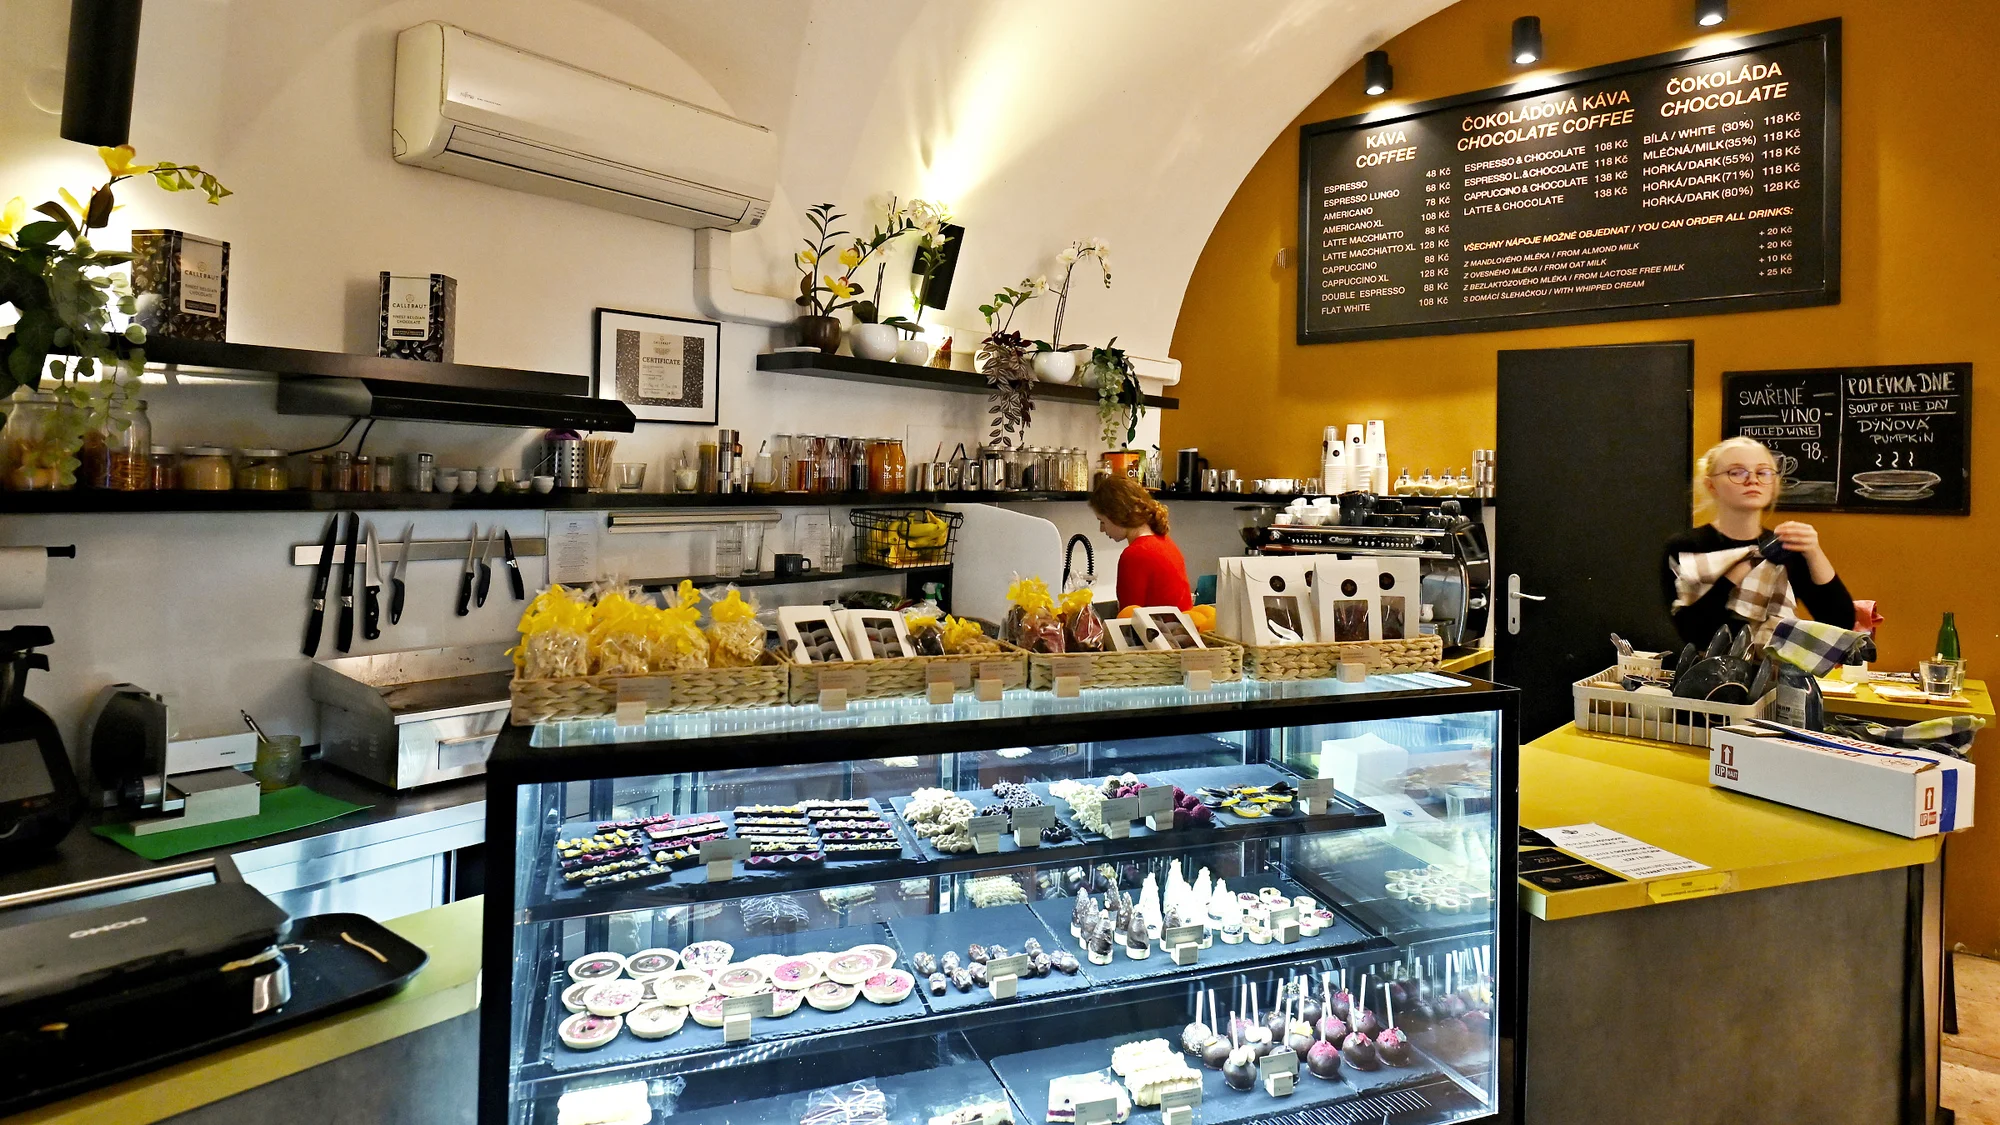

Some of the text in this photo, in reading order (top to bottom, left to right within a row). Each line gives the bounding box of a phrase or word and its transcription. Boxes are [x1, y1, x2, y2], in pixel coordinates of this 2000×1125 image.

[1666, 62, 1782, 95] ČOKOLÁDA
[1462, 90, 1630, 132] ČOKOLÁDOVÁ KÁVA
[1660, 82, 1789, 117] CHOCOLATE
[1457, 108, 1634, 151] CHOCOLATE COFFEE
[1643, 111, 1800, 144] BÍLÁ WHITE (30%) 118 Kč
[1763, 131, 1783, 142] 118
[1785, 128, 1800, 139] Kč
[1366, 131, 1406, 149] KÁVA
[1761, 148, 1782, 159] 118
[1785, 145, 1800, 156] Kč
[1355, 146, 1417, 168] COFFEE
[1464, 157, 1514, 172] ESPRESSO
[1524, 145, 1585, 163] CHOCOLATE
[1594, 141, 1612, 152] 108
[1614, 139, 1628, 149] Kč
[1324, 167, 1450, 194] ESPRESSO 48 Kč
[1464, 172, 1512, 186] ESPRESSO
[1594, 157, 1612, 167] 118
[1614, 154, 1628, 164] Kč
[1762, 165, 1782, 175] 118
[1785, 162, 1800, 172] Kč
[1323, 181, 1450, 207] ESPRESSO LUNGO 68 Kč
[1463, 185, 1521, 201] CAPPUCCINO
[1529, 176, 1588, 192] CHOCOLATE
[1594, 172, 1612, 182] 138
[1615, 170, 1627, 180] Kč
[1763, 181, 1783, 192] 128
[1784, 179, 1800, 189] Kč
[1323, 196, 1450, 220] AMERICANO 78 Kč
[1464, 204, 1492, 215] LATTE
[1502, 194, 1563, 210] CHOCOLATE
[1594, 188, 1612, 198] 138
[1614, 186, 1627, 195] Kč
[1322, 210, 1450, 234] AMERICANO XL 108 Kč
[1463, 240, 1504, 251] VŠECHNY
[1505, 235, 1542, 246] NÁPOJE
[1578, 225, 1630, 238] OBJEDNAT
[1638, 221, 1659, 231] YOU
[1661, 218, 1684, 229] CAN
[1685, 214, 1723, 226] ORDER
[1724, 212, 1745, 222] ALL
[1748, 206, 1793, 219] DRINKS:
[1323, 224, 1449, 247] LATTE MACCHIATTO 88 Kč
[1523, 252, 1549, 261] MLÉKA
[1556, 248, 1580, 257] FROM
[1581, 244, 1617, 255] ALMOND
[1618, 242, 1639, 251] MILK
[1767, 227, 1778, 235] 20
[1780, 226, 1792, 234] Kč
[1322, 238, 1449, 261] LATTE MACCHIATTO XL 128 Kč
[184, 270, 219, 280] CALLEBAUT
[1322, 253, 1449, 274] CAPPUCCINO 88 Kč
[1511, 265, 1538, 274] MLÉKA
[1544, 262, 1567, 271] FROM
[1568, 260, 1586, 268] OAT
[1586, 258, 1606, 266] MILK
[1539, 275, 1567, 283] MLÉKA
[1573, 272, 1598, 280] FROM
[1599, 267, 1637, 278] LACTOSE
[1639, 265, 1661, 274] FREE
[1663, 263, 1684, 272] MILK
[1767, 254, 1778, 262] 10
[1780, 253, 1792, 261] Kč
[1321, 267, 1448, 288] CAPPUCCINO XL 128 Kč
[1554, 286, 1574, 294] WITH
[1575, 283, 1612, 292] WHIPPED
[1614, 280, 1644, 289] CREAM
[1767, 268, 1777, 276] 25
[1321, 282, 1448, 301] DOUBLE ESPRESSO 88 Kč
[1321, 296, 1448, 314] FLAT WHITE 108 Kč
[642, 356, 681, 366] CERTIFICATE
[1739, 380, 1806, 406] SVAŘENÉ
[1846, 372, 1955, 396] POLÉVKA DNE
[1848, 399, 1948, 415] SOUP OF THE DAY
[1744, 427, 1817, 436] MULLED WINE
[1716, 765, 1726, 777] UP
